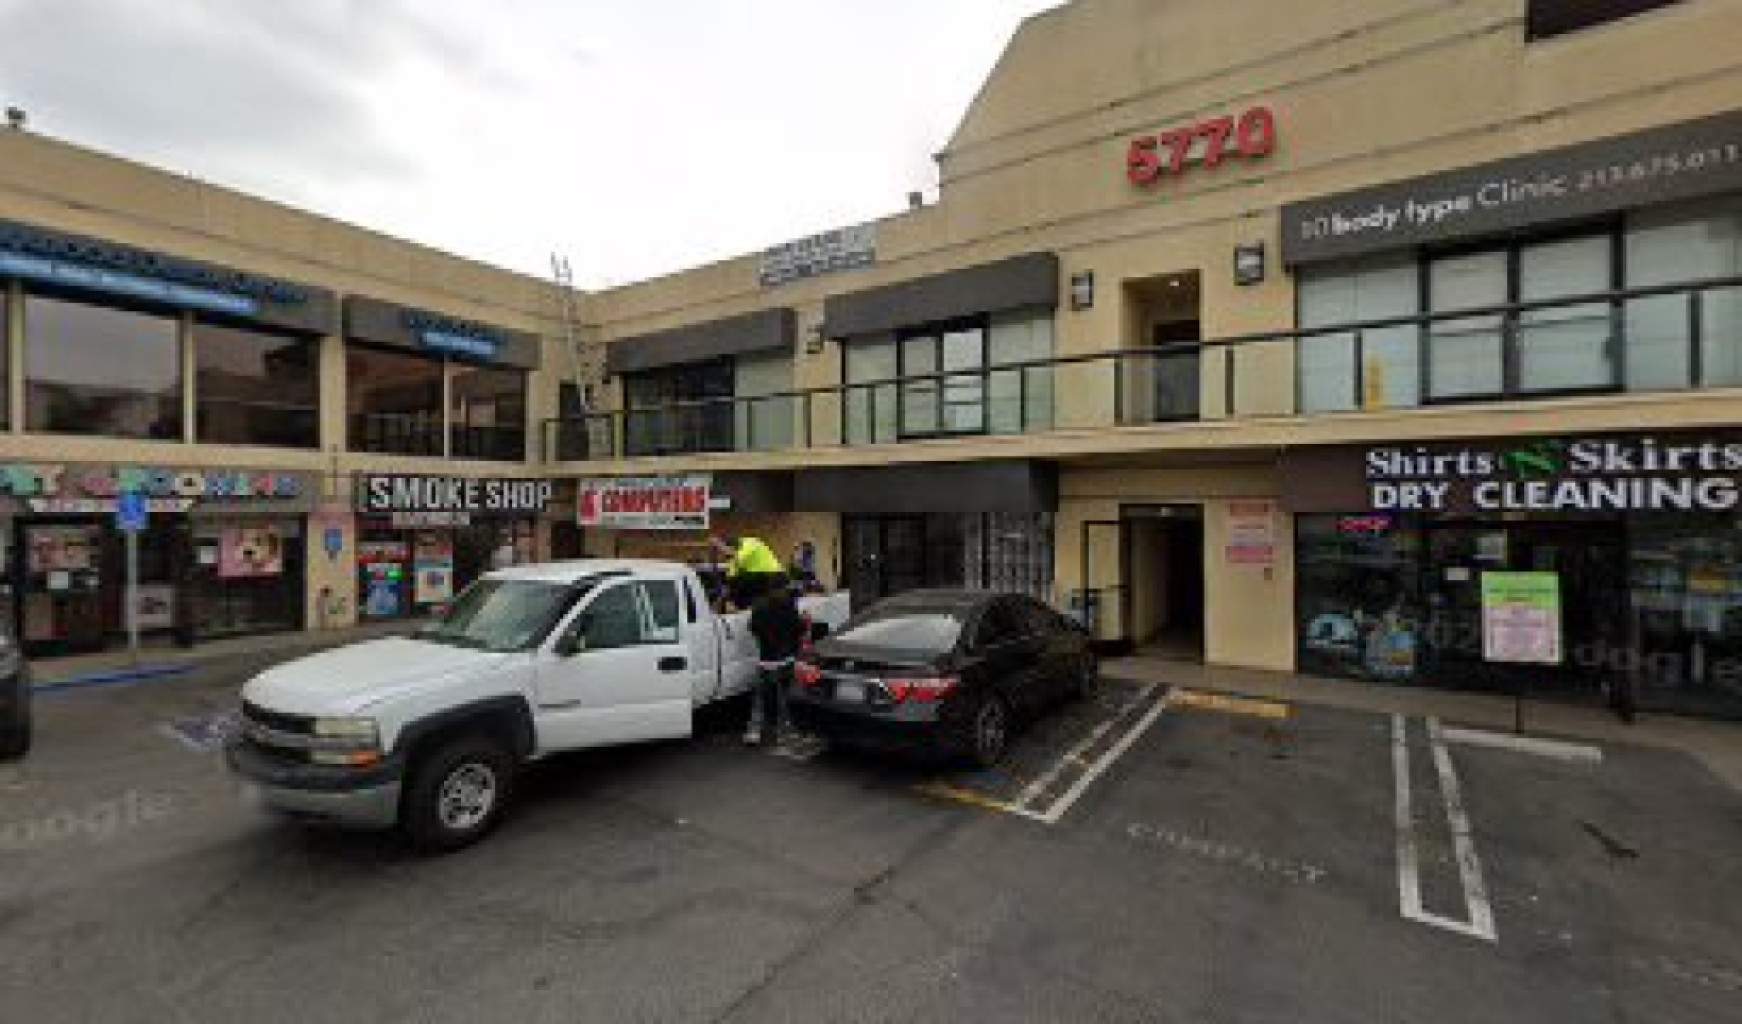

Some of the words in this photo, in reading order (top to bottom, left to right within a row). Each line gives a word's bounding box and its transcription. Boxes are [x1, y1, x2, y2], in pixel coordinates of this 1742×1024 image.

[1127, 105, 1275, 186] 5770
[1331, 203, 1400, 233] body
[1404, 195, 1472, 228] type
[1476, 170, 1568, 207] Clinic
[1365, 446, 1493, 478] Shirts
[1568, 436, 1742, 474] Skirts
[370, 476, 480, 510] SMOKE
[485, 479, 553, 510] SHOP
[1373, 481, 1450, 509] DRY
[1472, 477, 1739, 510] CLEANING
